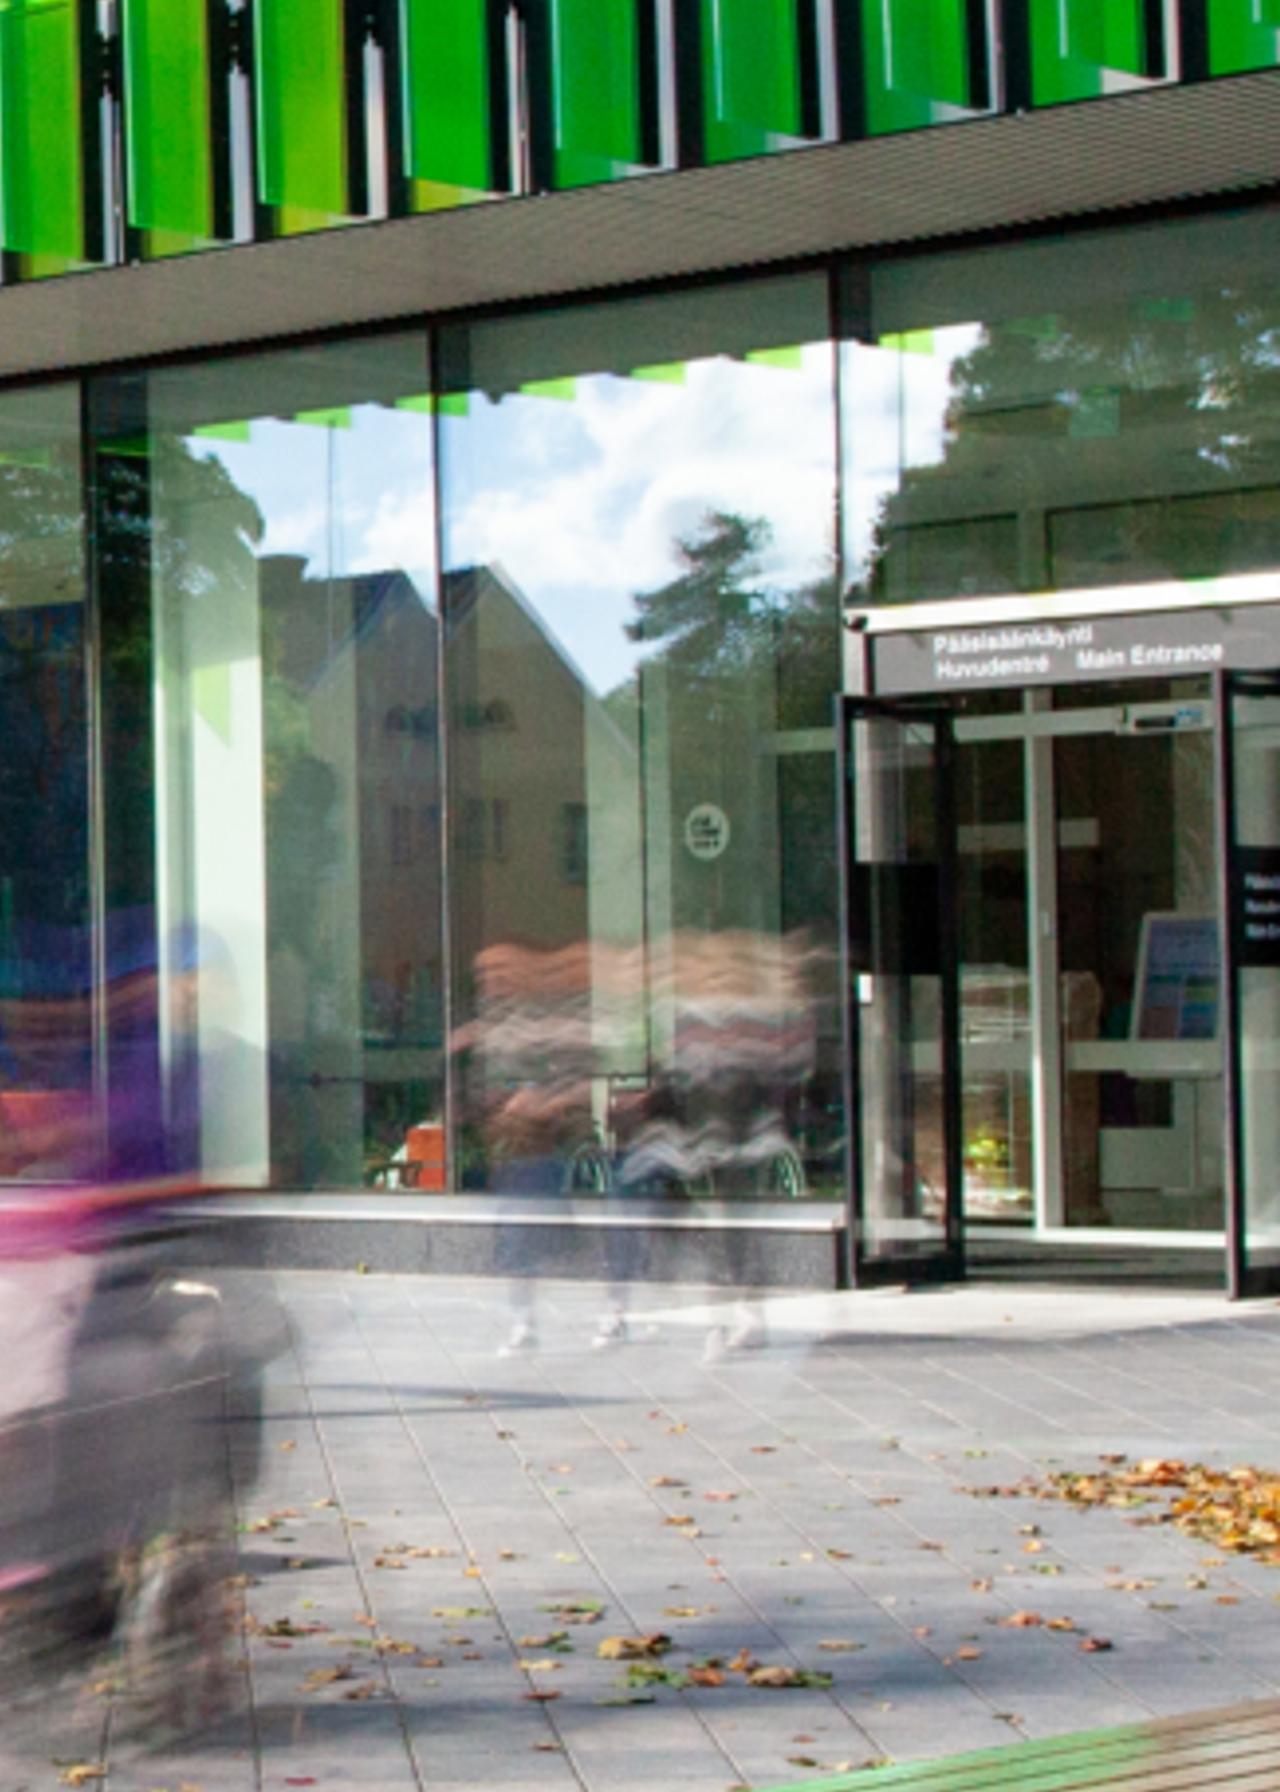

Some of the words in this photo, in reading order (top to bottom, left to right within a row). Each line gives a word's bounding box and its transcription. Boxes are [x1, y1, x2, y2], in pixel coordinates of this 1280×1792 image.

[935, 654, 1050, 679] Huvudentré
[1076, 648, 1124, 670] Main
[1130, 642, 1224, 666] Entrance
